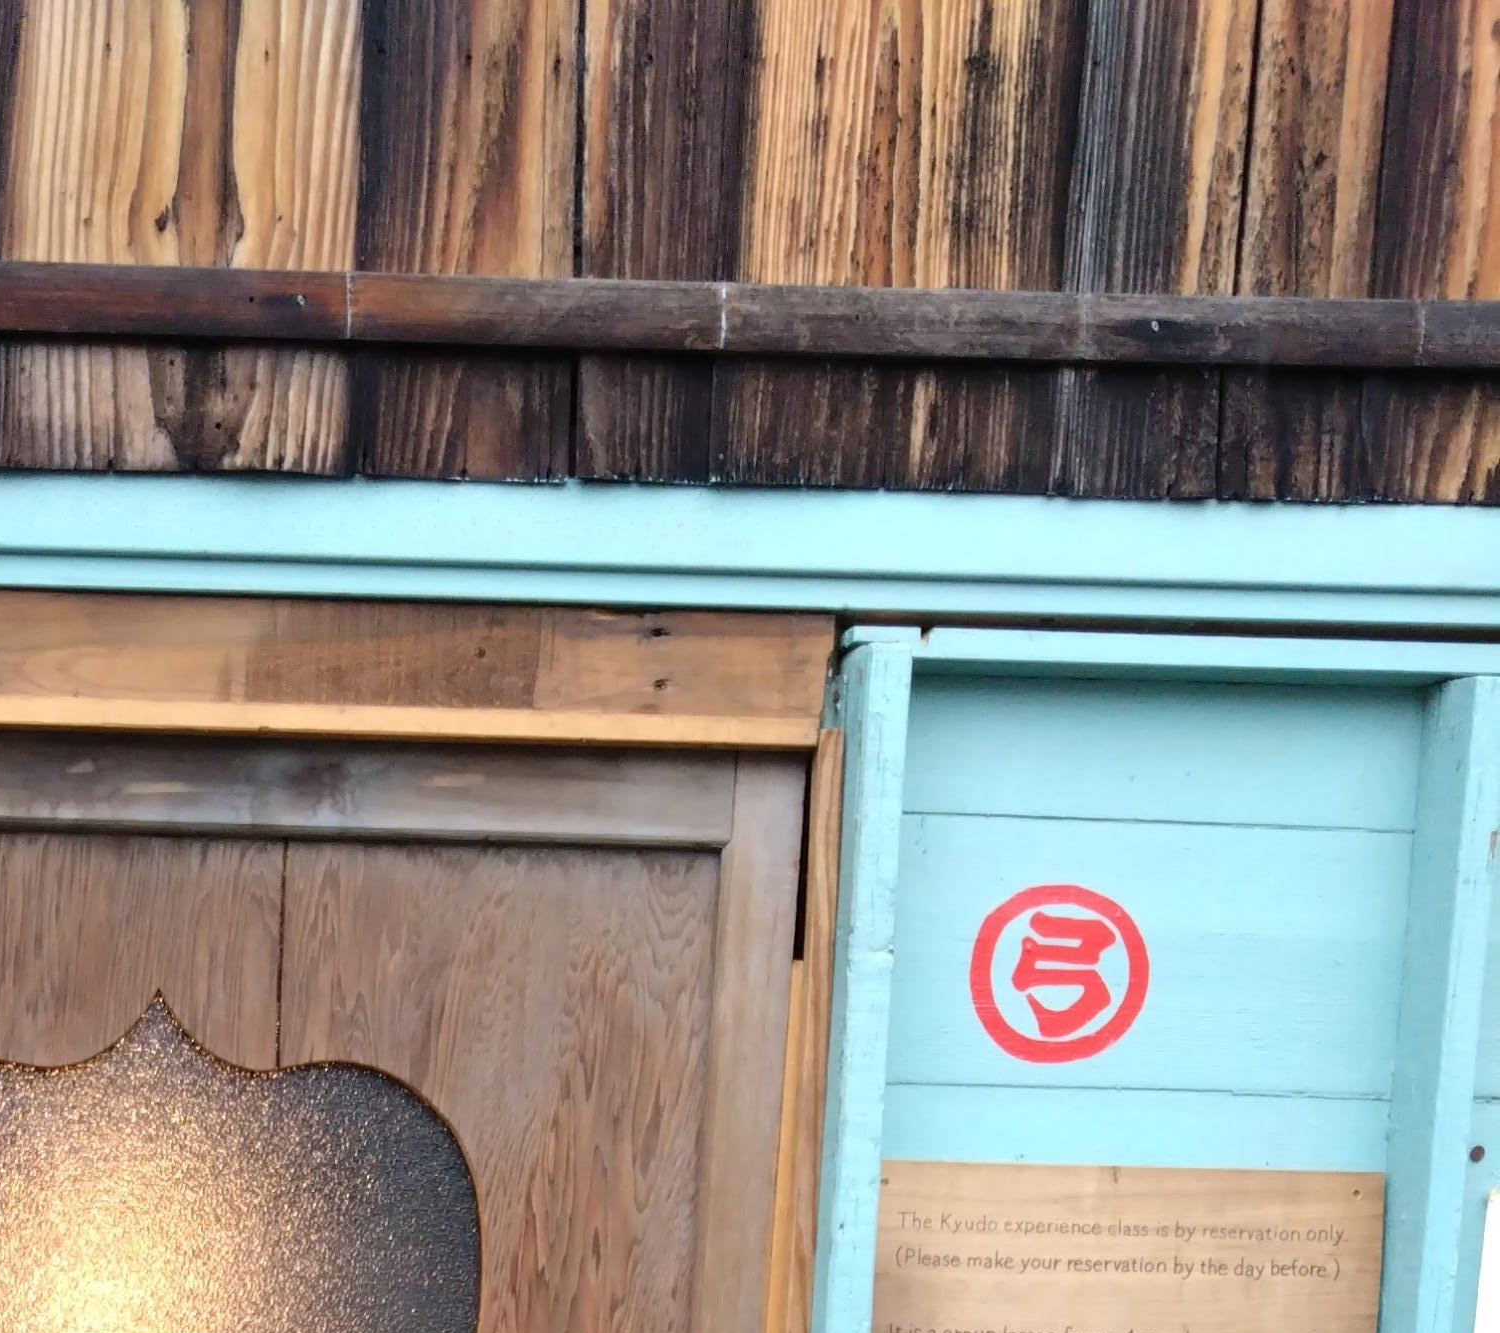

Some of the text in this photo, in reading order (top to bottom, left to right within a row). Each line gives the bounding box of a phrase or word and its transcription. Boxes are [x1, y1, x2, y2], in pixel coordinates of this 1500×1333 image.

[897, 1211, 933, 1231] The
[940, 1212, 998, 1234] Kyudo
[1004, 1217, 1102, 1236] experience
[1108, 1218, 1149, 1237] class
[1156, 1221, 1169, 1238] is
[1175, 1220, 1196, 1242] by
[1202, 1223, 1301, 1242] reservation
[895, 1245, 961, 1268] (Please
[967, 1250, 1014, 1270] make
[1019, 1256, 1062, 1274] your
[1067, 1255, 1168, 1274] reservation
[1173, 1256, 1194, 1280] by
[1200, 1257, 1228, 1277] the
[1233, 1257, 1264, 1280] day
